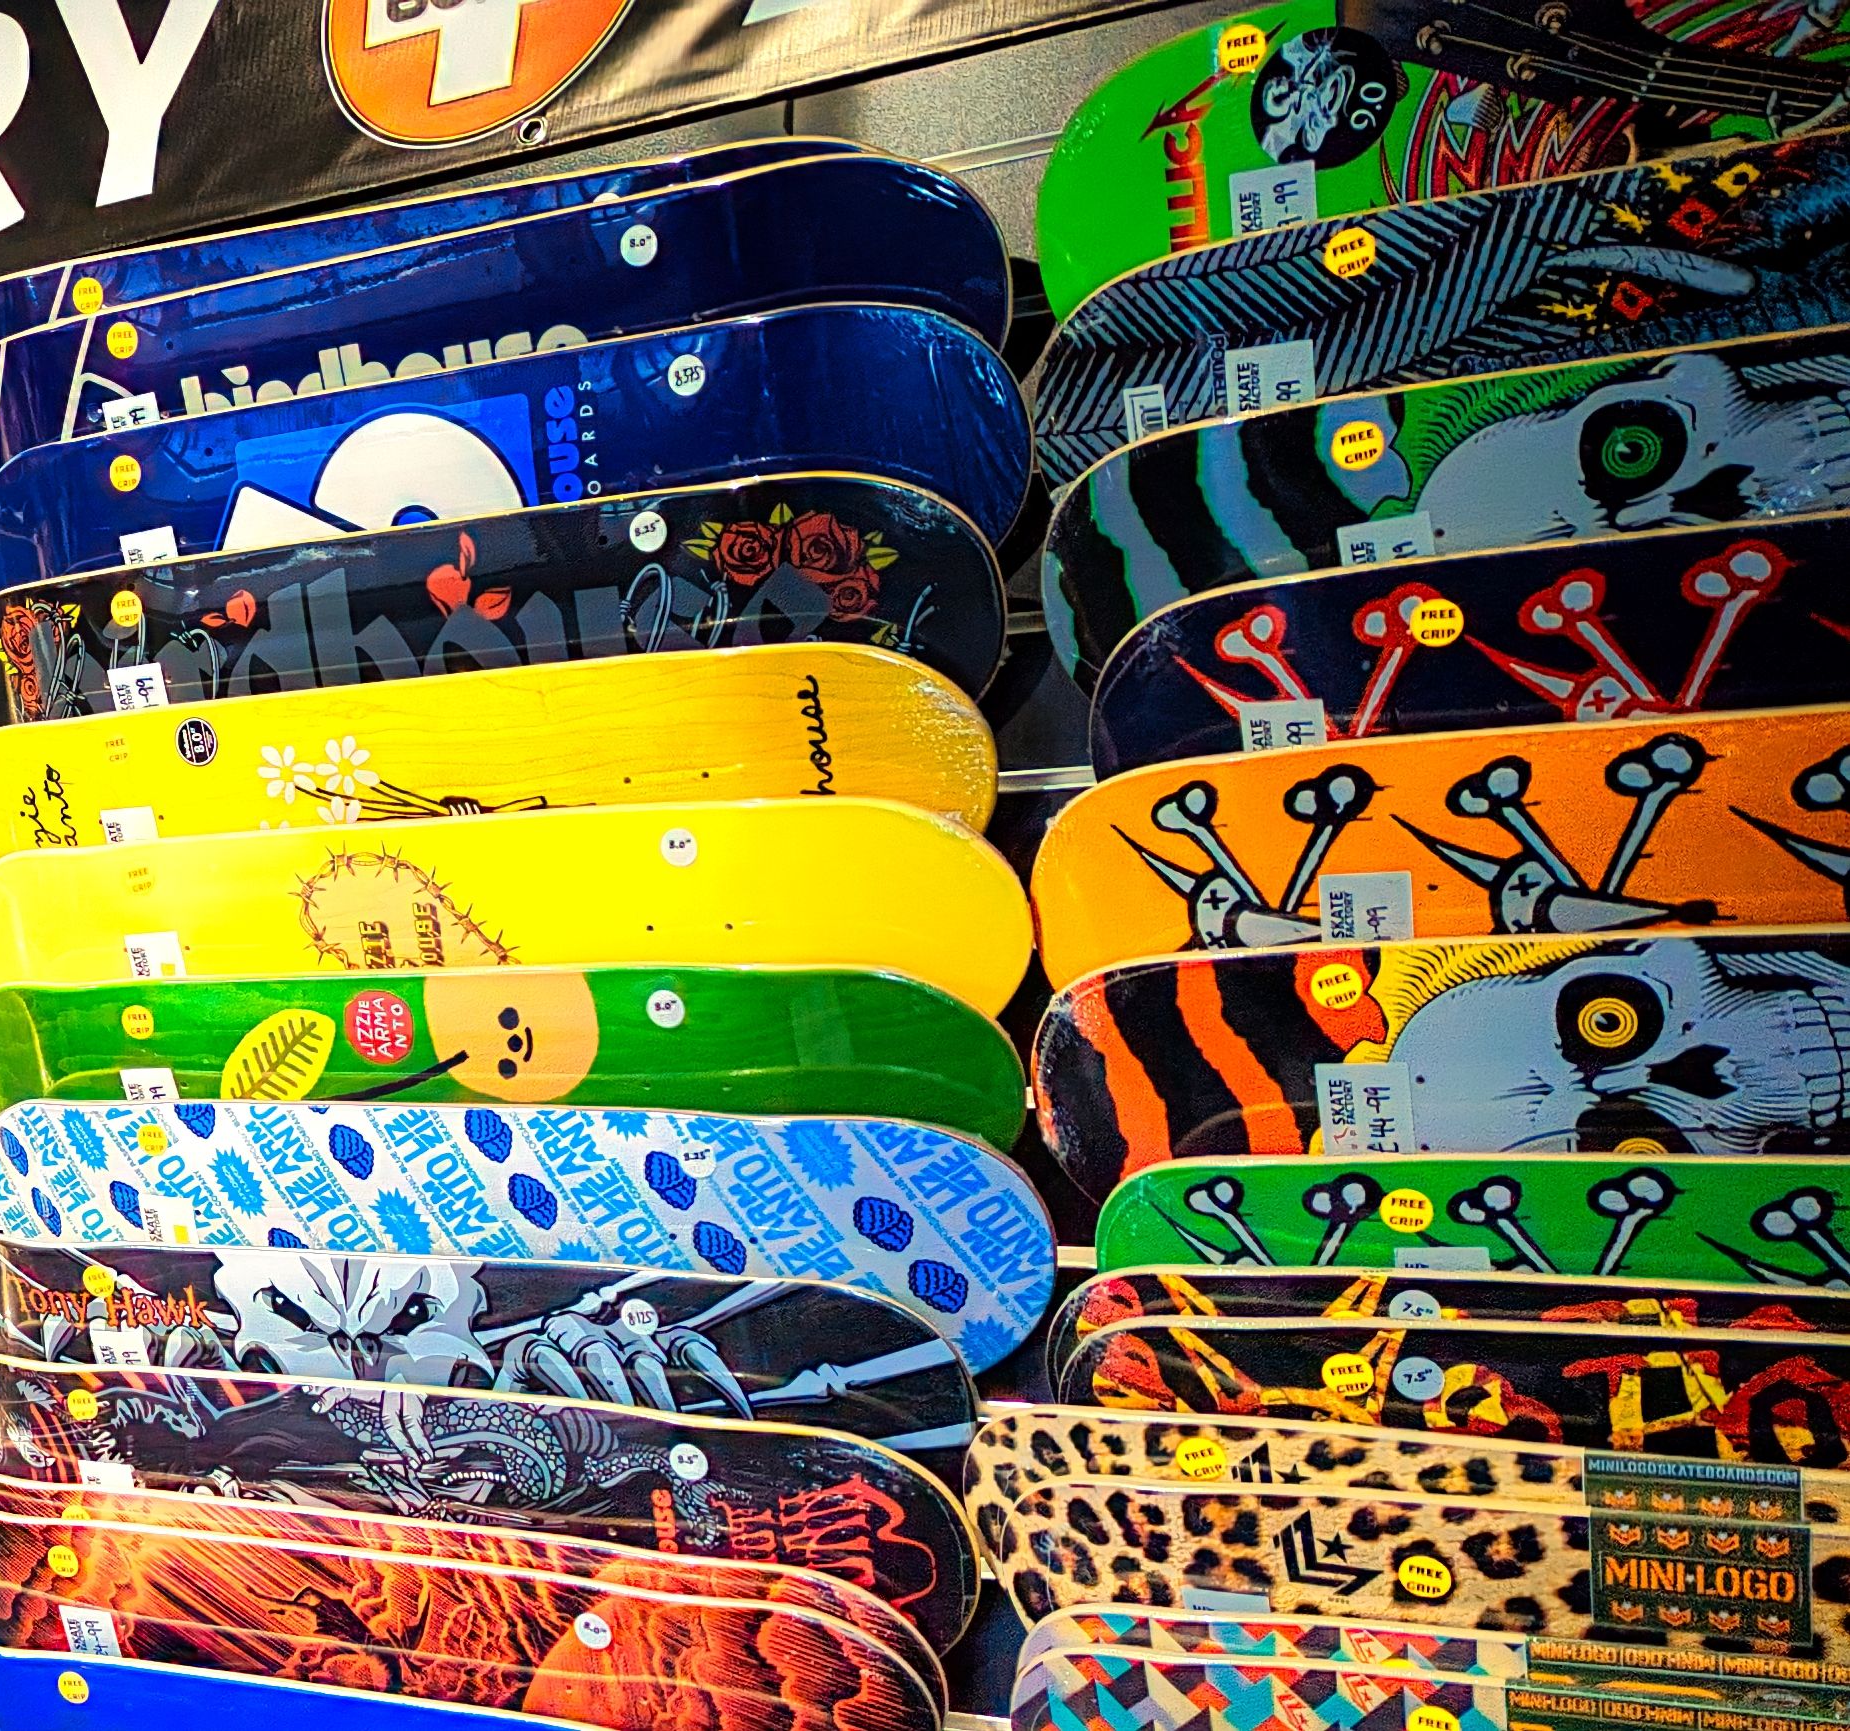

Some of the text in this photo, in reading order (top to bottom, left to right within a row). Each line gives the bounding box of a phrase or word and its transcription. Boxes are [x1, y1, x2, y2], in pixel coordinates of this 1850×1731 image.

[1226, 34, 1258, 50] FREE
[1331, 237, 1367, 258] FREE
[1336, 258, 1370, 277] GRIP
[78, 285, 98, 296] FREE
[113, 330, 133, 340] FREE
[1236, 361, 1252, 413] SKATE
[1340, 428, 1376, 446] FREE
[1343, 447, 1379, 465] GRIP
[115, 464, 136, 474] FREE
[116, 599, 137, 609] FREE
[1420, 608, 1457, 620] FREE
[1420, 628, 1457, 641] GRIP
[800, 674, 837, 796] house
[1331, 890, 1345, 939] SKATE
[1343, 891, 1355, 939] FACTORY
[1317, 973, 1352, 991] FREE
[1324, 990, 1357, 1008] GRIP
[127, 1012, 148, 1022] FREE
[390, 1002, 408, 1048] NTO
[356, 1000, 377, 1057] LIZZIE
[372, 997, 394, 1058] ARMA
[1331, 1078, 1344, 1126] SKATE
[1342, 1079, 1354, 1126] FACTORY
[140, 1130, 163, 1140] FREE
[1390, 1196, 1427, 1210] FREE
[1388, 1214, 1425, 1228] GRIP
[10, 1273, 218, 1331] Tony Hawk
[1329, 1364, 1365, 1377] FREE
[1335, 1381, 1369, 1394] GRIP
[1183, 1447, 1216, 1462] FREE
[1587, 1457, 1800, 1487] MINILOGOSKATEBOARDS.COM
[1407, 1564, 1444, 1578] FREE
